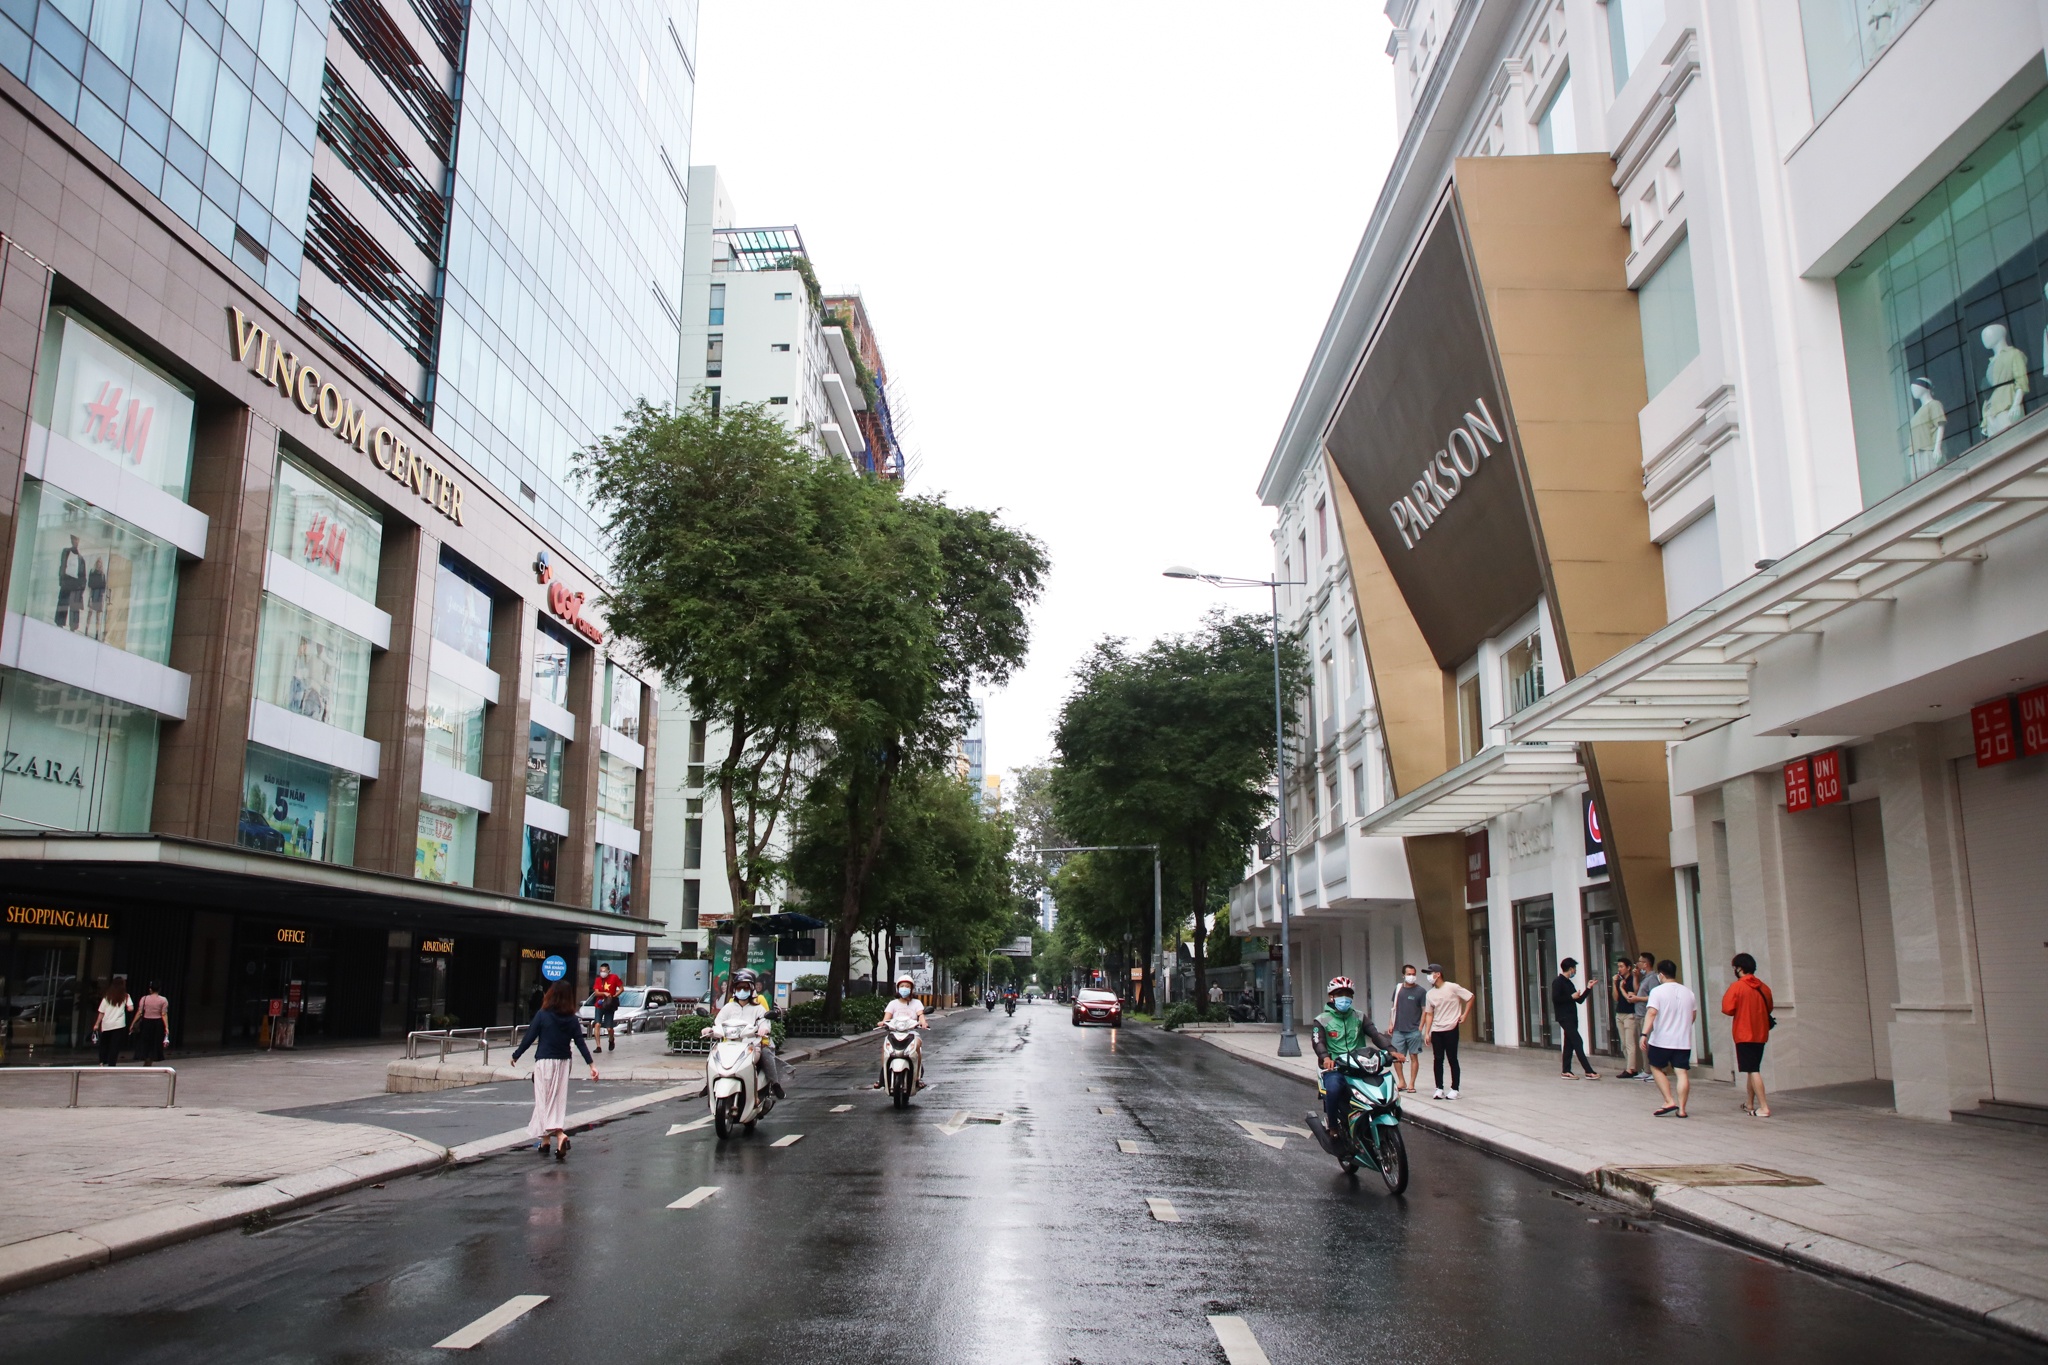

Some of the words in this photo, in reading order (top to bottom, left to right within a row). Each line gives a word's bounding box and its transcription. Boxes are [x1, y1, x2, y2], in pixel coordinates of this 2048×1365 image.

[84, 380, 155, 465] H&M
[229, 306, 368, 453] VINCOM
[370, 426, 466, 526] CENTER
[1389, 397, 1503, 551] PARKSON
[304, 512, 347, 576] H&M
[577, 618, 603, 644] CINEMAS
[1978, 707, 2006, 734] ユニ
[2022, 694, 2048, 721] UN
[1980, 733, 2009, 760] クロ
[2026, 723, 2048, 749] QL
[2, 750, 85, 789] ZARA
[1788, 766, 1806, 787] ユニ
[1814, 758, 1834, 779] UNI
[1789, 787, 1808, 808] クロ
[1817, 778, 1838, 802] QLO
[273, 787, 288, 821] 5
[289, 789, 305, 802] NĂM
[436, 819, 452, 841] U22
[1508, 822, 1554, 861] PARKSO
[7, 906, 74, 927] SHOPPING
[76, 912, 110, 929] MALL
[277, 928, 305, 943] OFFICE
[422, 941, 455, 954] APARTMENT
